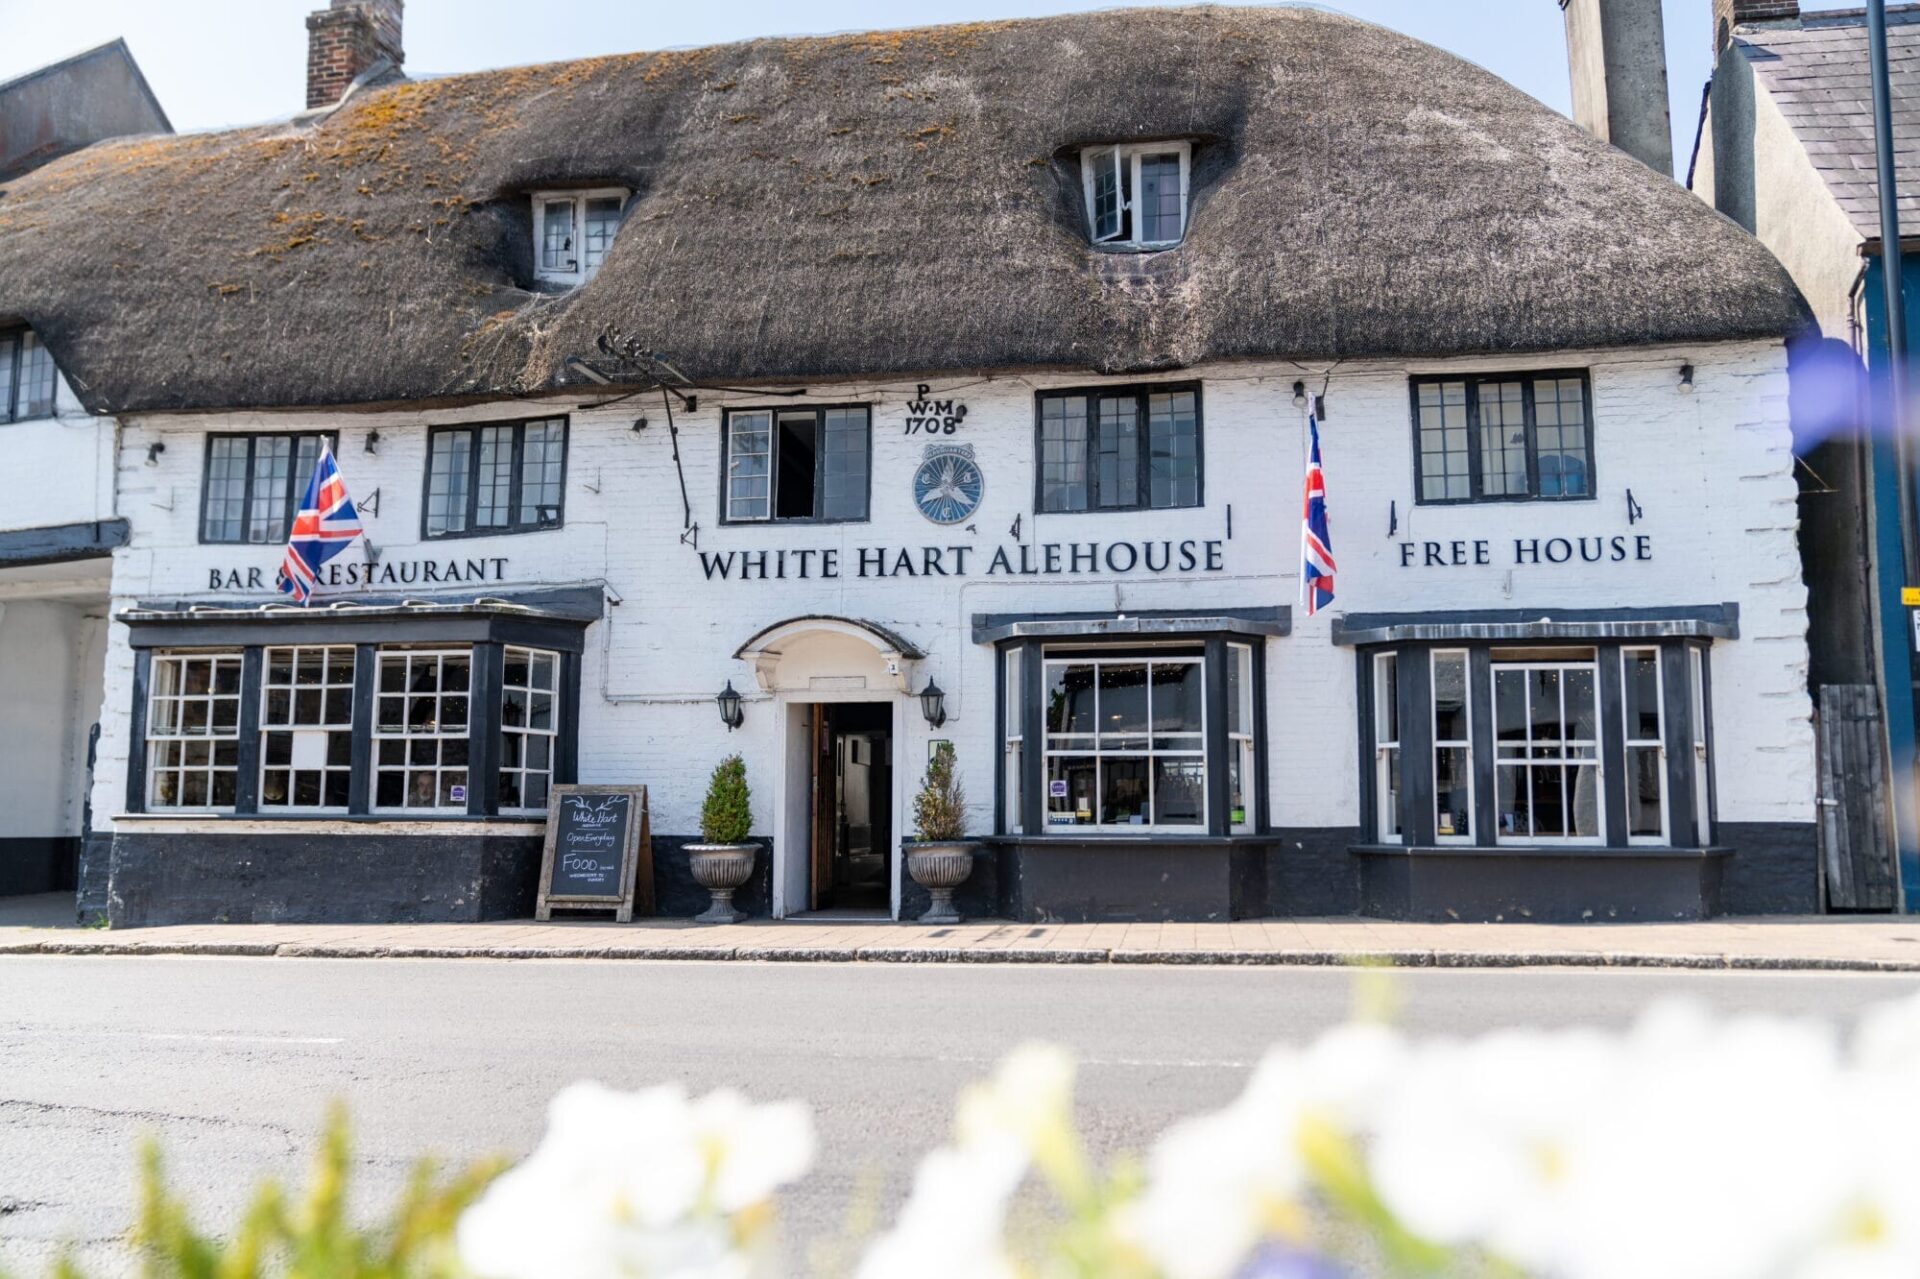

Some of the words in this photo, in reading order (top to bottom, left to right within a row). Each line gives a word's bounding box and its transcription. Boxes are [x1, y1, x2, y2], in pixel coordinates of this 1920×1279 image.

[917, 385, 930, 400] P
[698, 549, 839, 580] WHITE
[856, 546, 973, 577] HART
[985, 540, 1224, 575] ALEHOUSE
[1399, 540, 1490, 567] FREE
[1513, 535, 1652, 564] HOUSE
[208, 567, 264, 589] BAR
[596, 810, 618, 823] Hart
